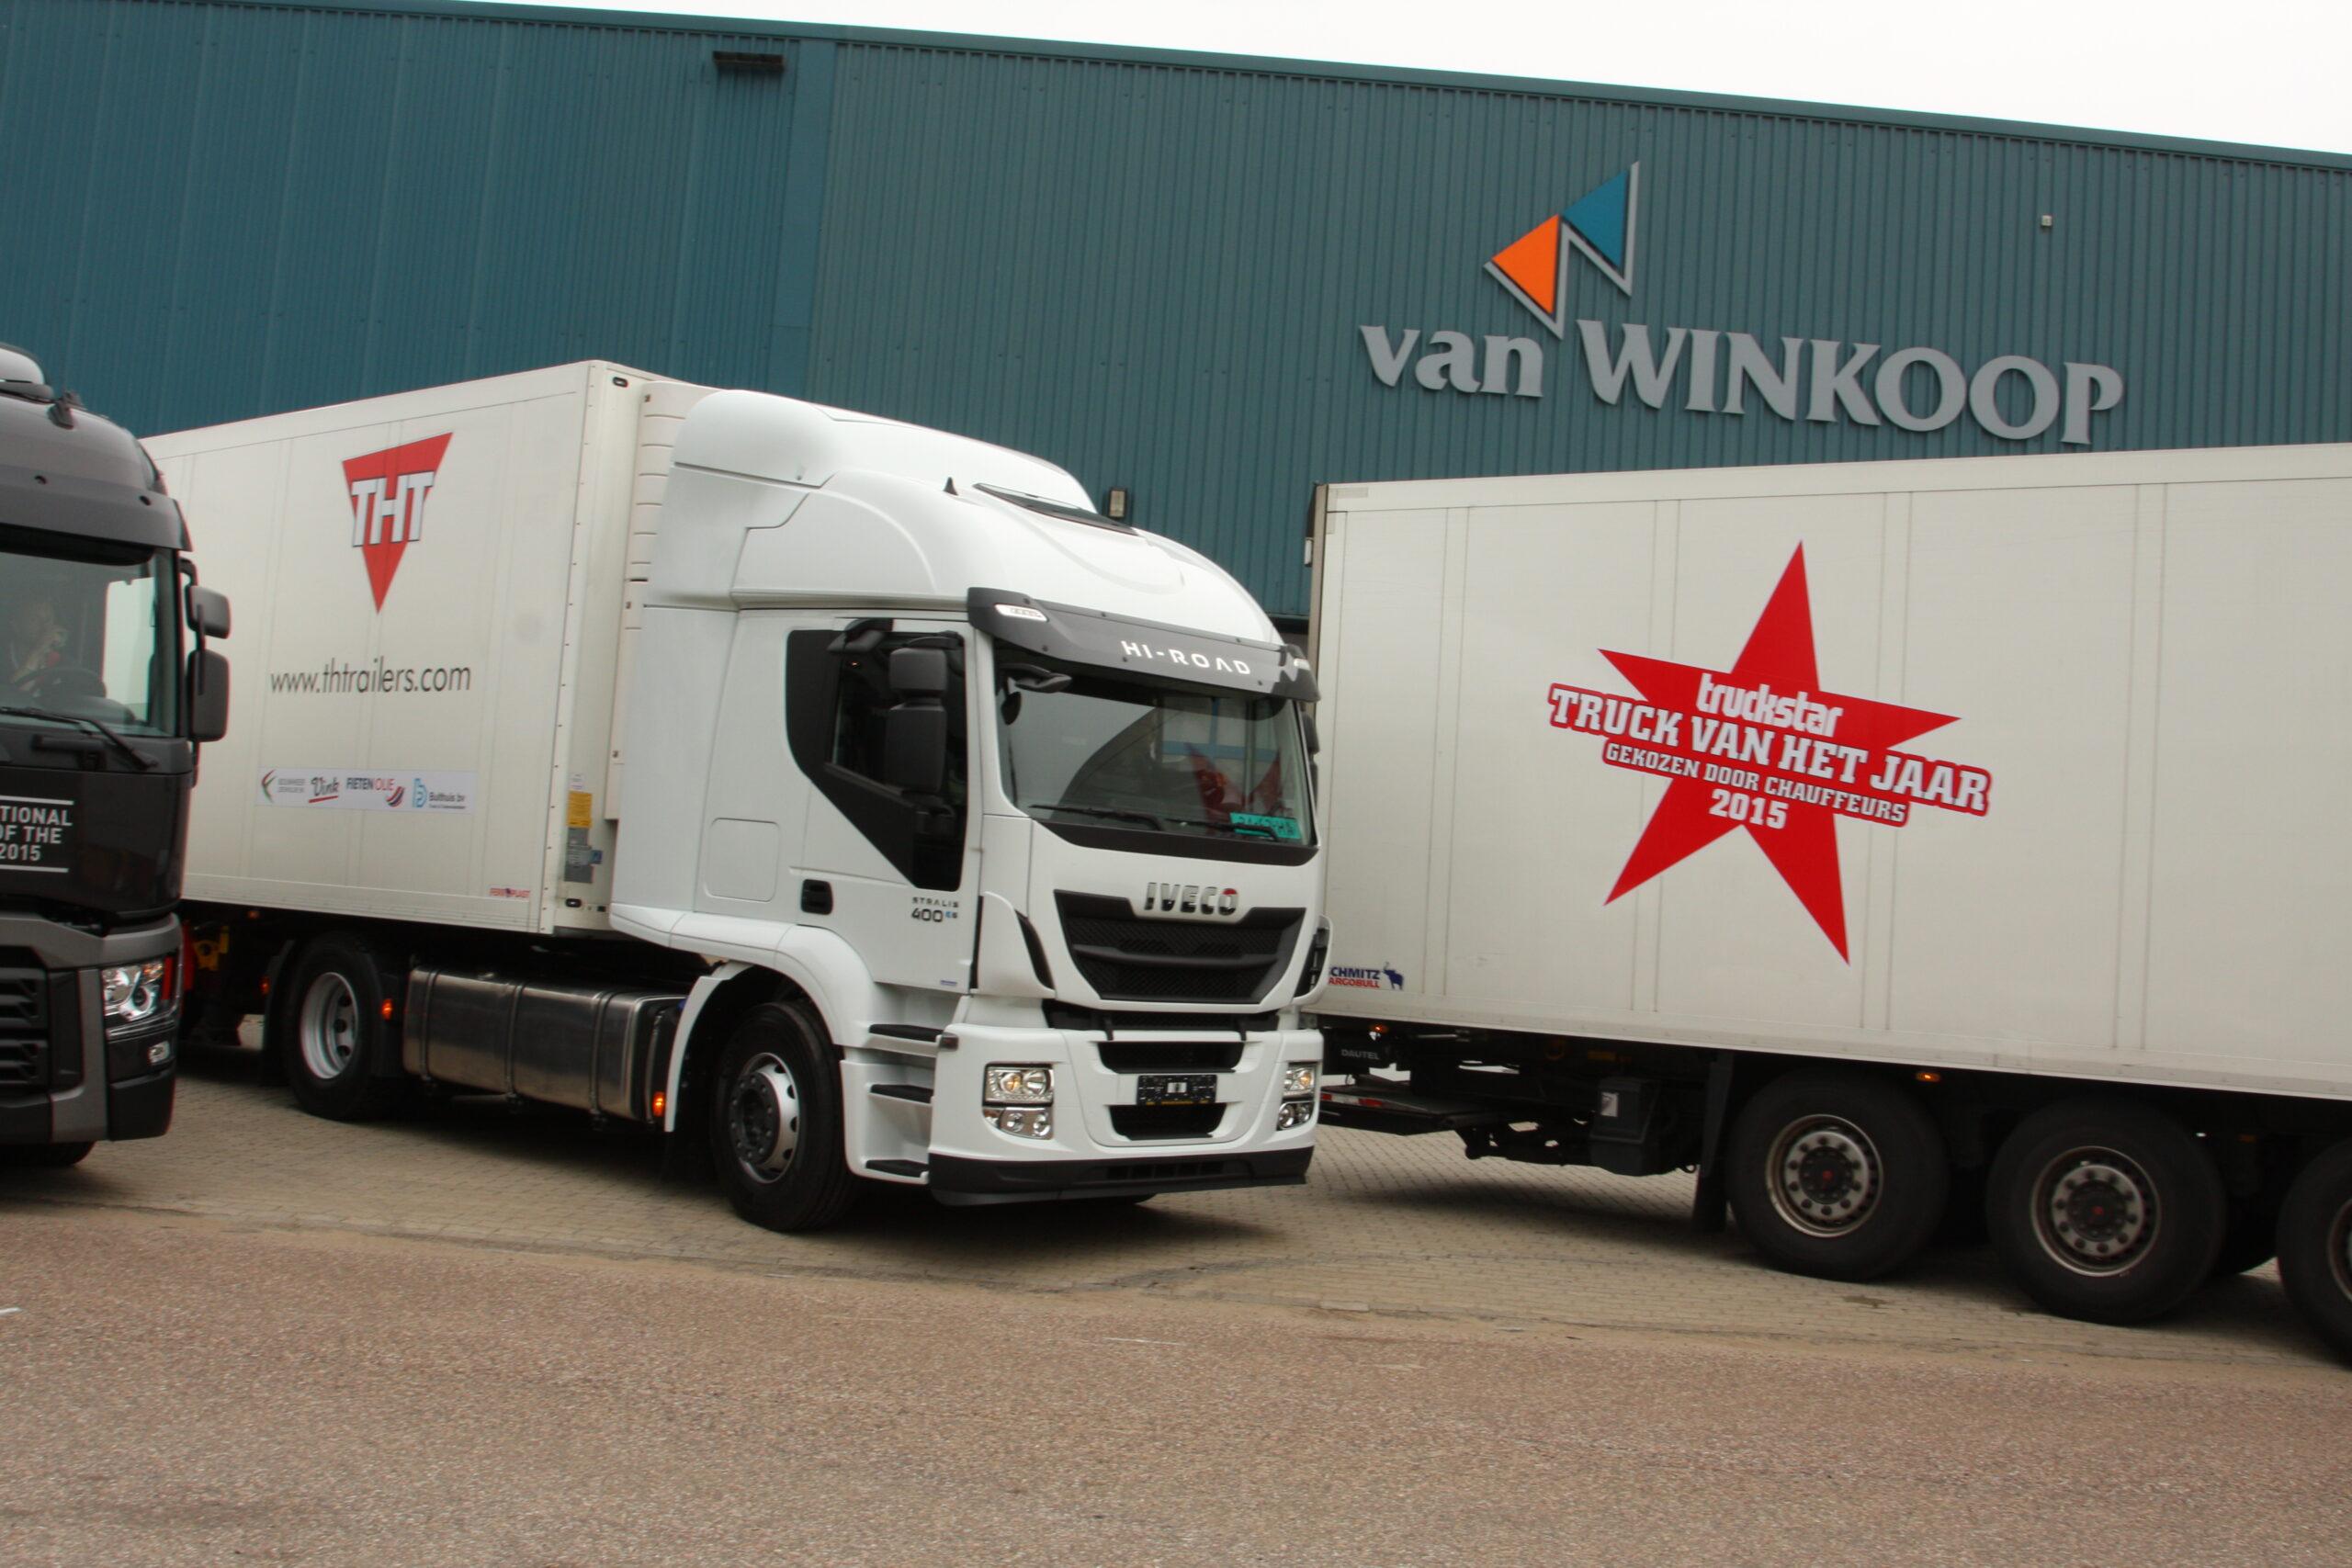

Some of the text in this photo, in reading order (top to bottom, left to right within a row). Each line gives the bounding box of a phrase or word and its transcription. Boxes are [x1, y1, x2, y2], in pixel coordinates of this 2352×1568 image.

[1359, 319, 2123, 445] van WINKOOP
[350, 469, 435, 547] THT
[1121, 640, 1251, 675] HI-ROAD
[270, 656, 472, 694] www.thtrailers.com
[1696, 672, 1844, 738] truckstar
[1552, 687, 1988, 812] TRUCK VAN HET JAAR
[1605, 741, 1908, 823] GEKOZEN DOOR CHAUFFEURS
[1708, 788, 1790, 829] 2015
[0, 842, 41, 861] 2015
[23, 826, 62, 843] THE
[911, 908, 943, 922] 400
[912, 897, 959, 908] STRALIS
[1144, 882, 1238, 916] IVECO
[1329, 966, 1381, 980] CHMITZ
[1329, 976, 1380, 988] ARGOBULL
[1341, 1049, 1380, 1061] DAUTEL
